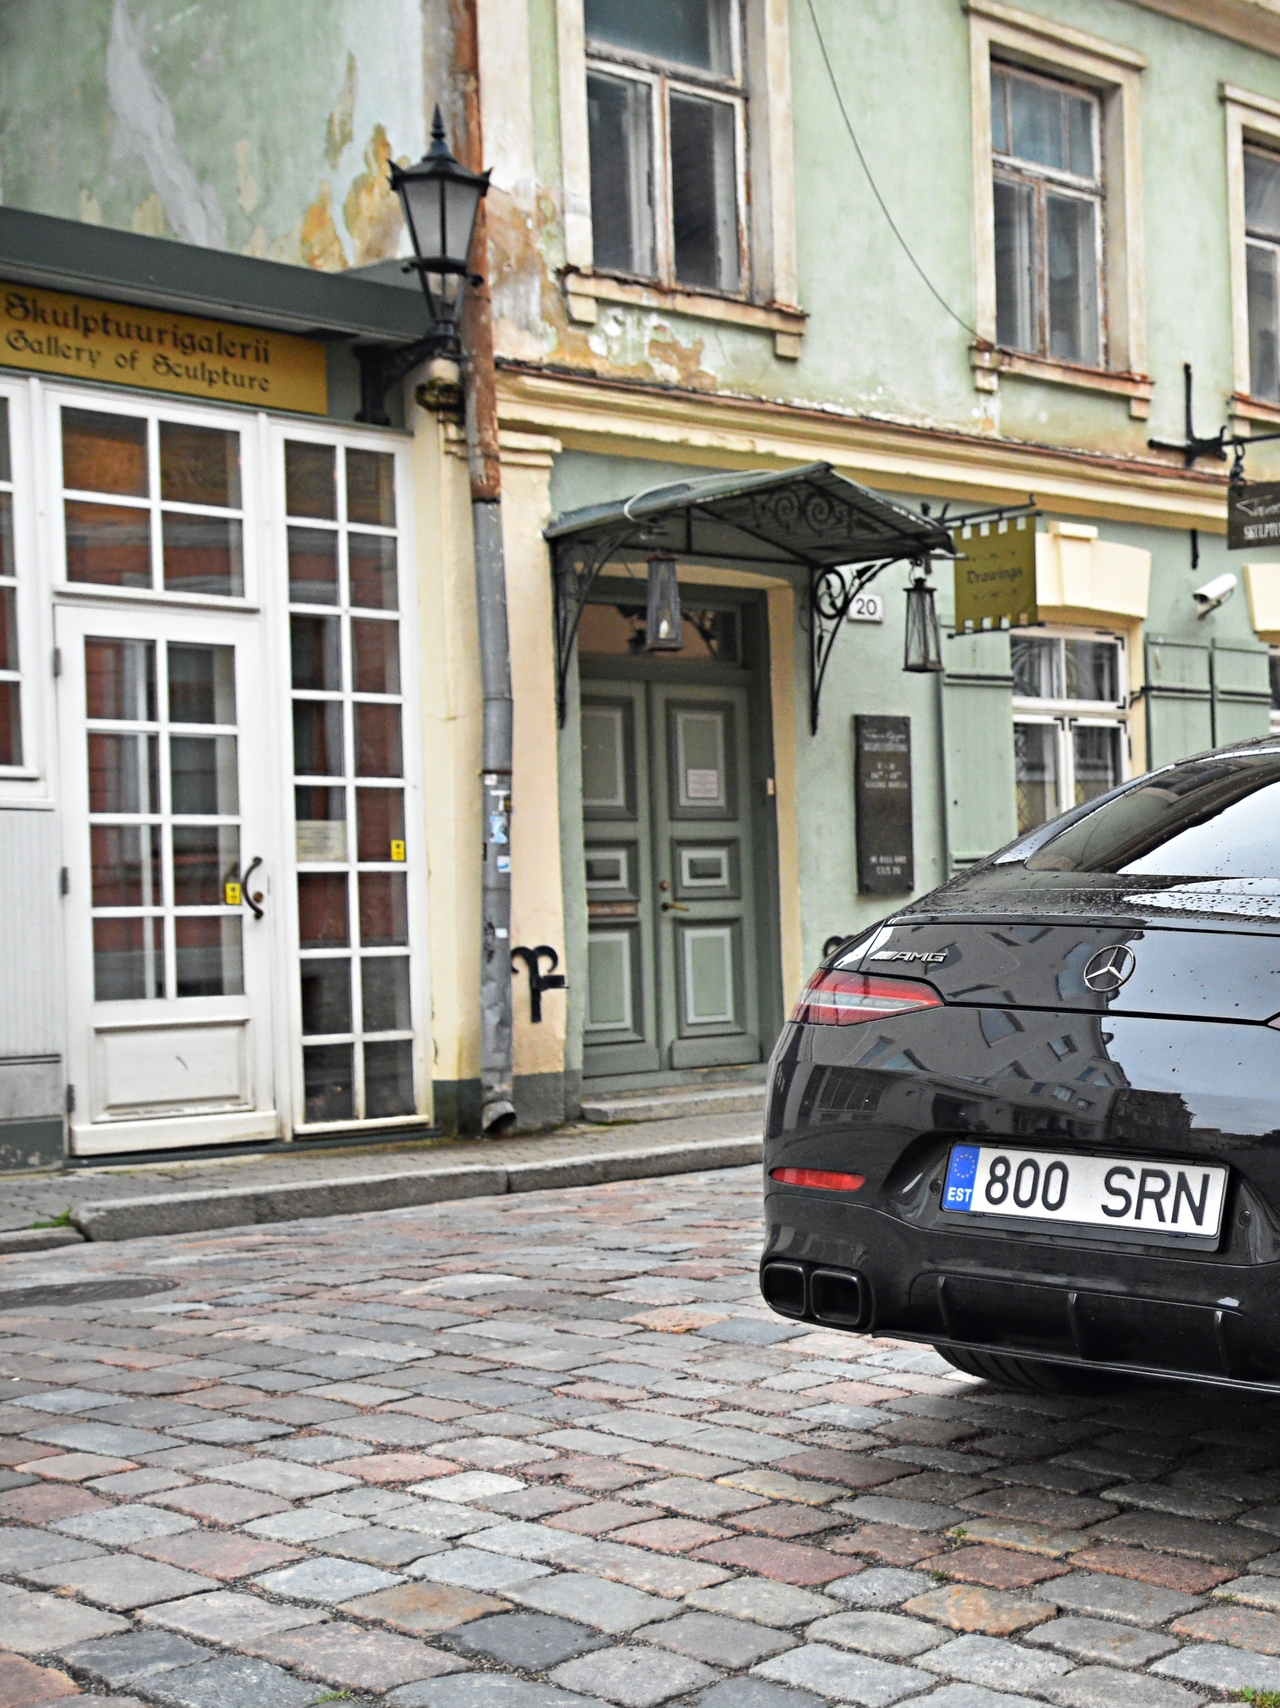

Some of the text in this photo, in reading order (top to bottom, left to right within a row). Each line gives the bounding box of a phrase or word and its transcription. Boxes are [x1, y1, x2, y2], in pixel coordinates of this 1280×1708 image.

[5, 292, 271, 364] Skulptuurigalerii
[5, 328, 271, 392] Gallery of Sculpture
[856, 597, 877, 616] 20
[891, 951, 948, 963] AMG
[947, 1186, 973, 1203] EST
[984, 1155, 1211, 1227] 800 SRN
